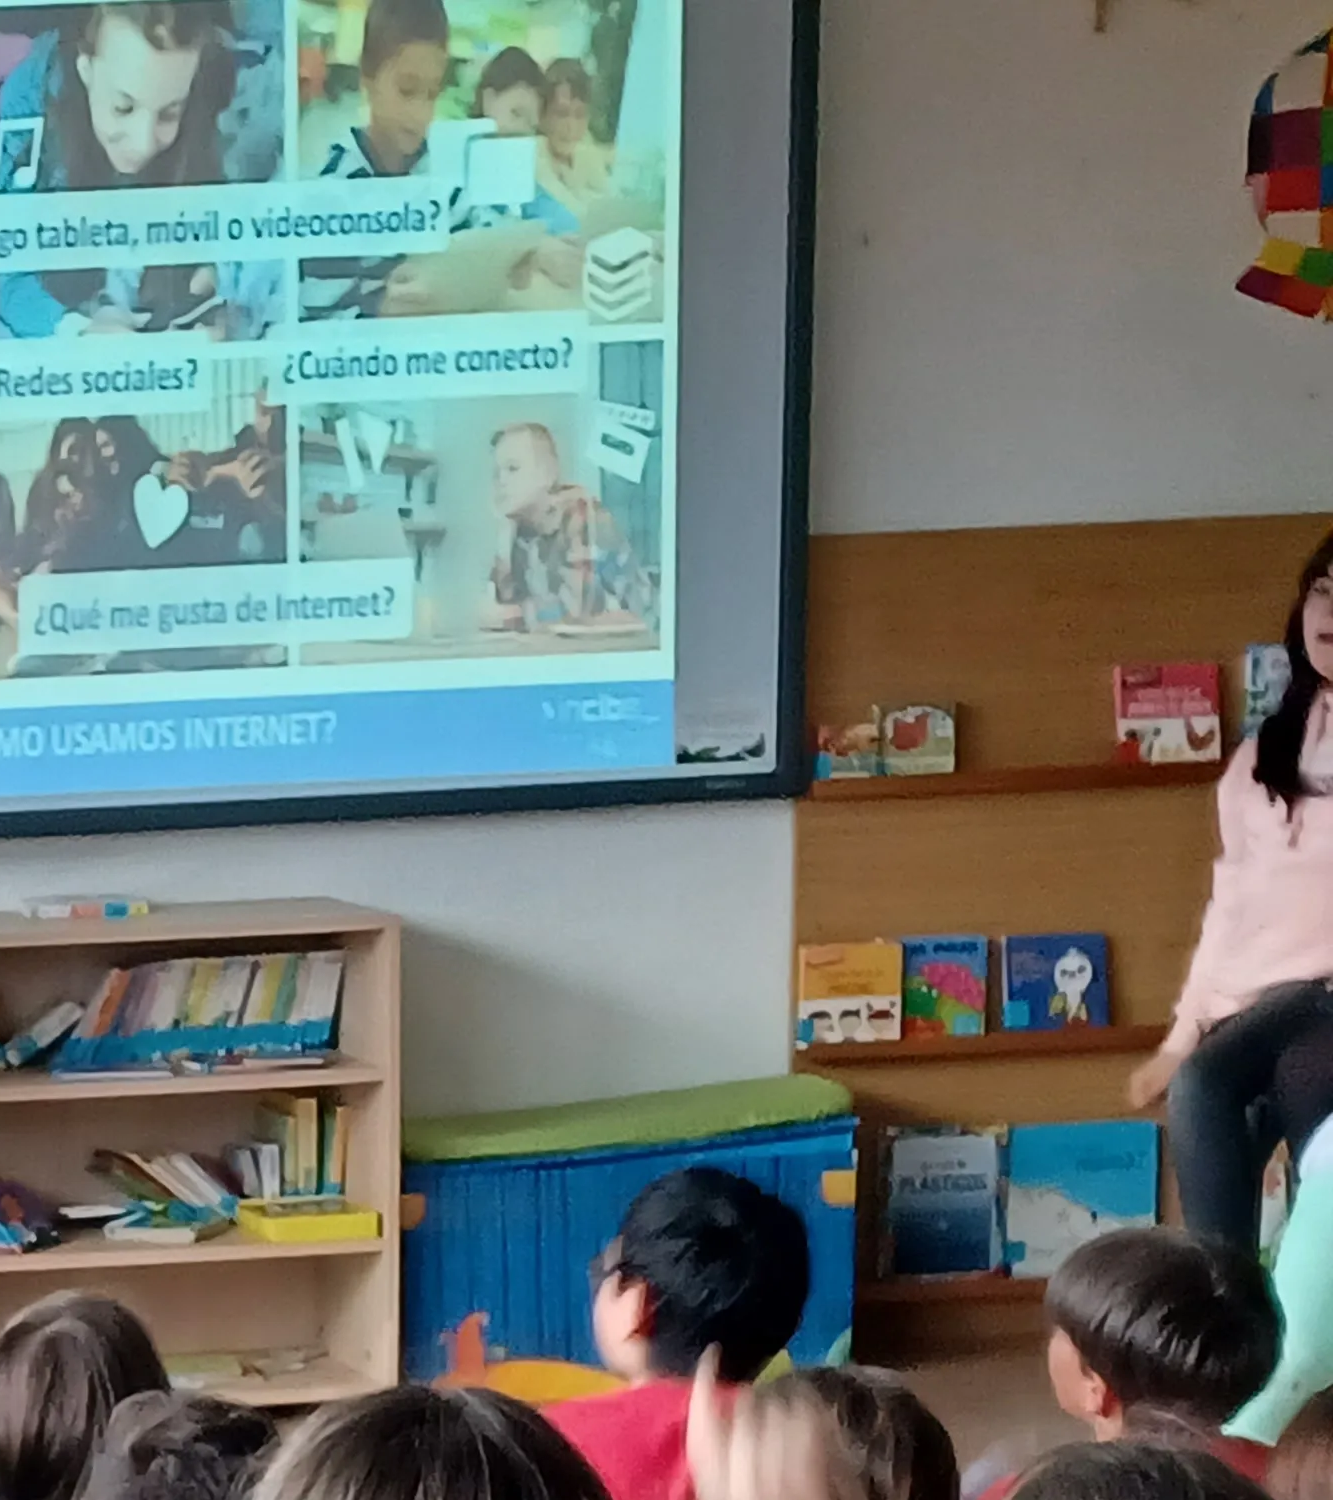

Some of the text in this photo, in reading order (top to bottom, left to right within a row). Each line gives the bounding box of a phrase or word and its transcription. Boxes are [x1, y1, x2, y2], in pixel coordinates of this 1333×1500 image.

[37, 215, 139, 250] tableta,
[146, 209, 219, 245] móvil
[227, 217, 244, 240] o
[250, 199, 441, 238] videoconsola?
[82, 358, 198, 394] sociales?
[282, 336, 574, 384] ¿Cuándo me conecto?
[33, 586, 396, 636] ¿Qué me gusta de Internet?
[50, 719, 177, 755] USAMOS
[184, 711, 337, 748] INTERNET?
